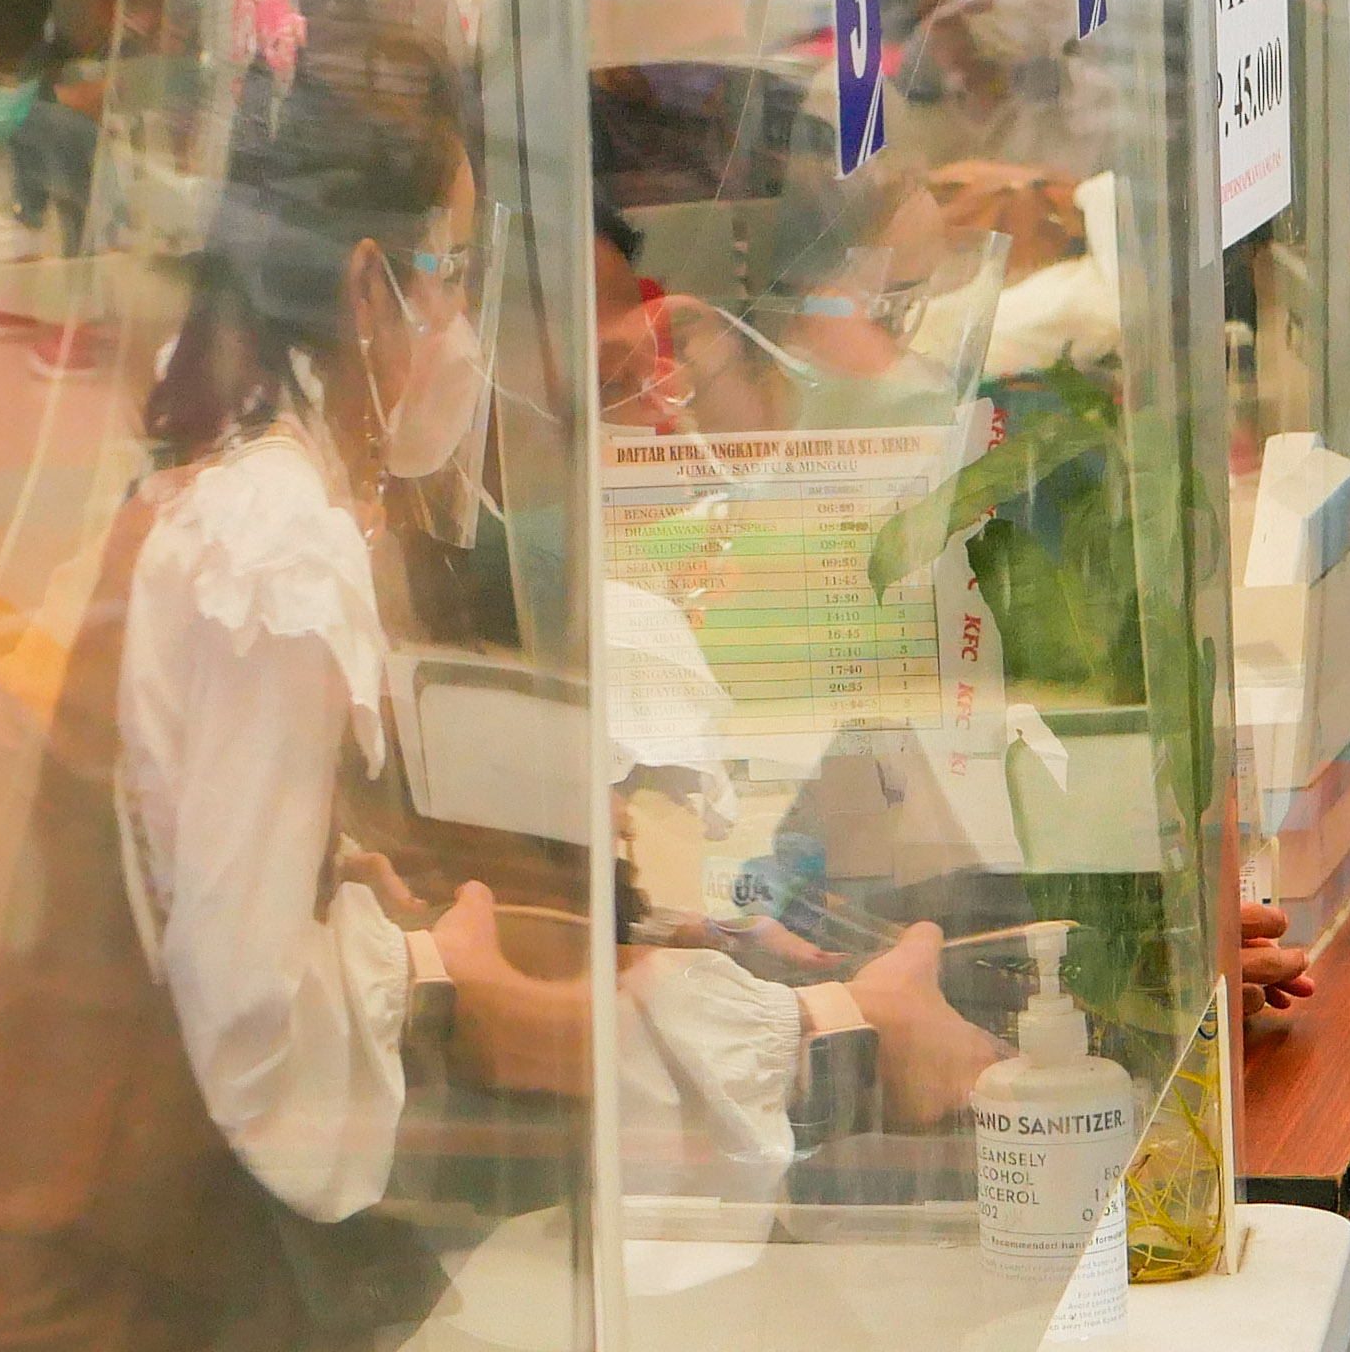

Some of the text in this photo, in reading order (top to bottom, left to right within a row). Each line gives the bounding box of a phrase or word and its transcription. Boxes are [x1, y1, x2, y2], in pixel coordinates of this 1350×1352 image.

[1234, 36, 1282, 129] 45.000
[617, 445, 665, 464] DAFTAR
[785, 461, 796, 473] &
[800, 459, 859, 474] MINGGU
[624, 506, 690, 520] BENGAWA
[961, 613, 981, 662] KFC
[955, 682, 975, 729] KFC
